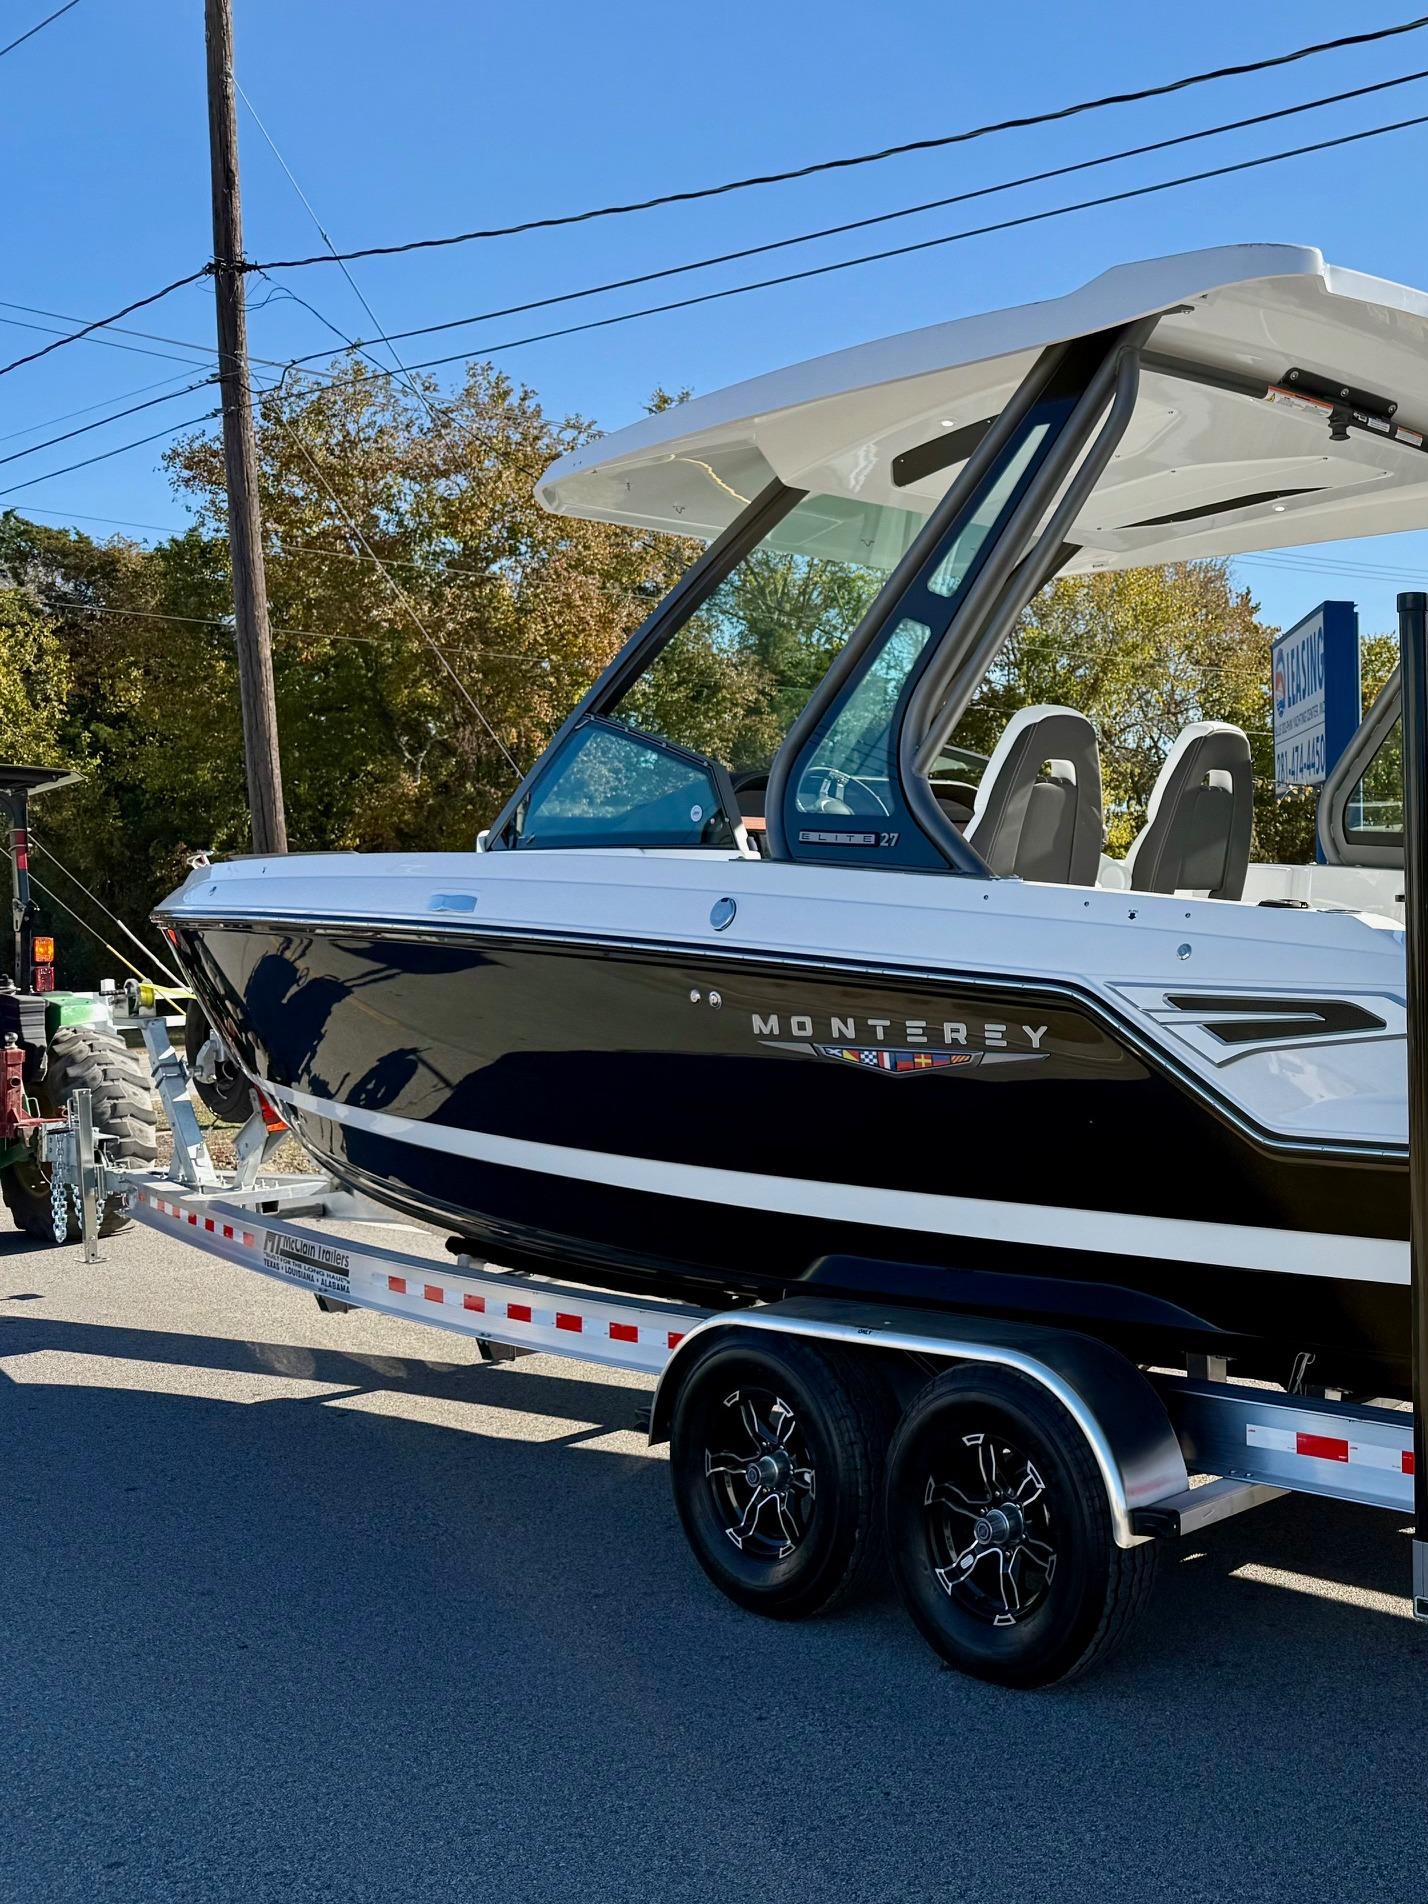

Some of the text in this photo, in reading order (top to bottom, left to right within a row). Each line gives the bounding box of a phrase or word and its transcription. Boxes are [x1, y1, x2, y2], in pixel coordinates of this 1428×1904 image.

[1286, 626, 1324, 708] LEASING
[801, 832, 899, 847] ELITE 27
[752, 1014, 1048, 1049] MONTEREY
[283, 1236, 350, 1268] McClain Trailers
[263, 1258, 351, 1294] TEXAS LOUISIANA ALABAMA
[303, 1265, 325, 1277] LONG
